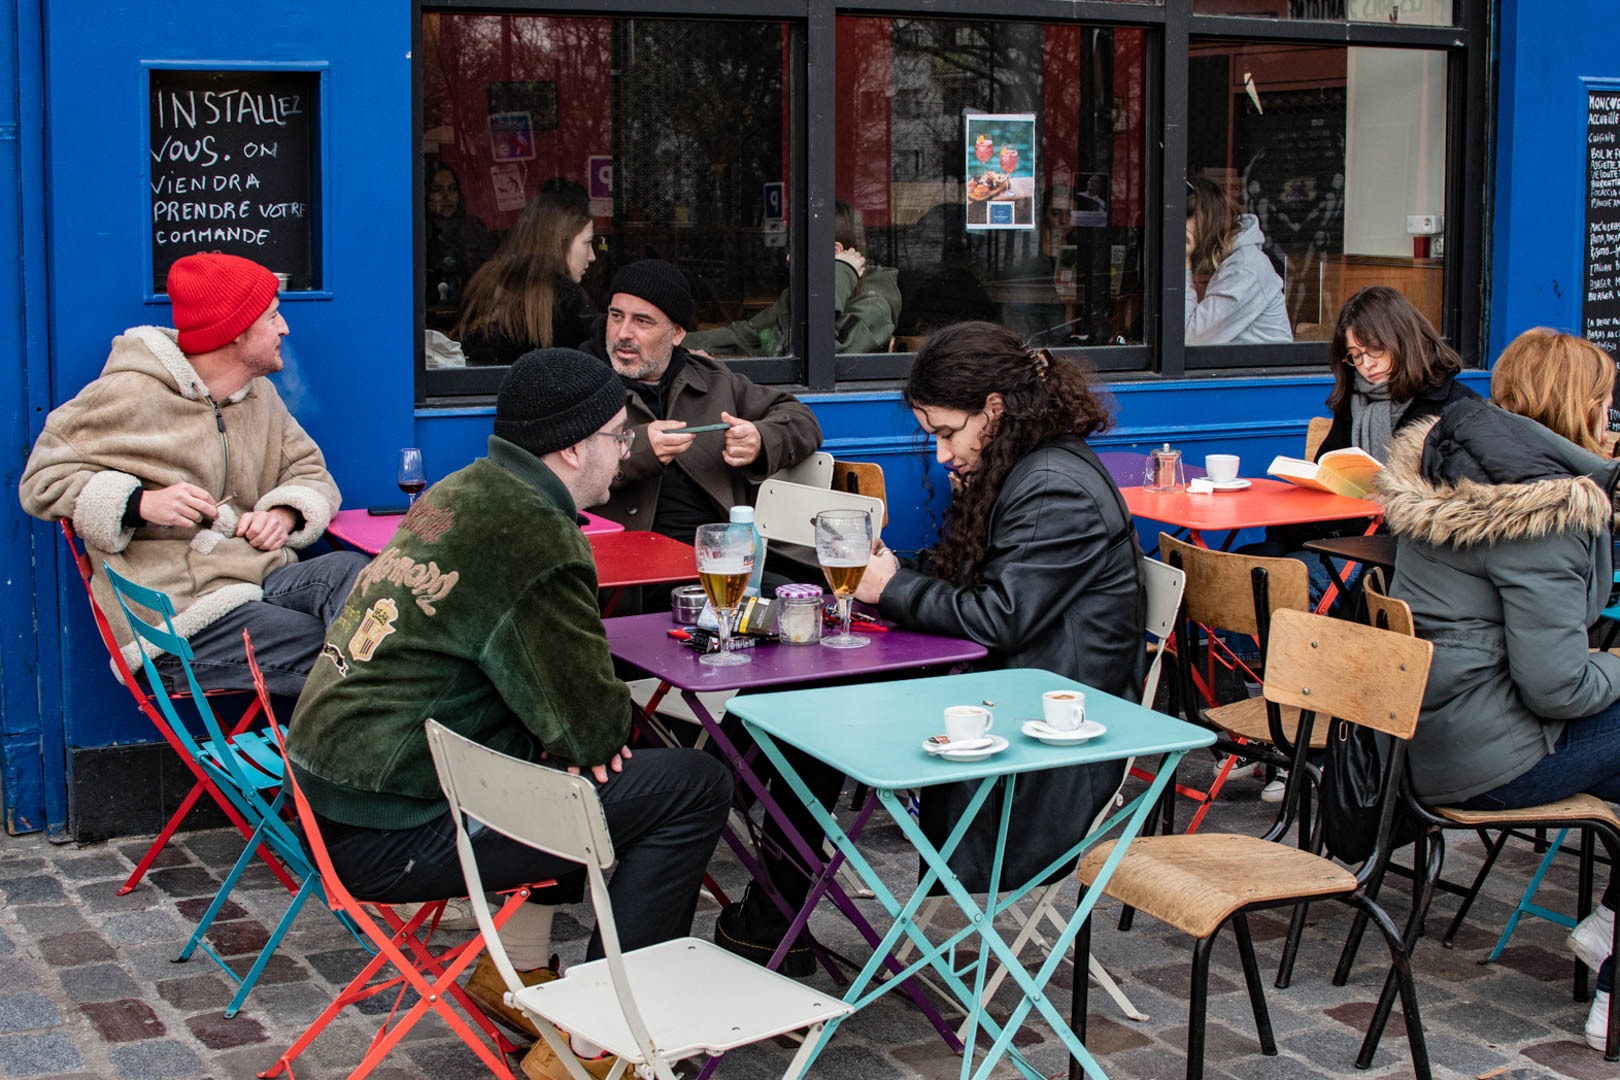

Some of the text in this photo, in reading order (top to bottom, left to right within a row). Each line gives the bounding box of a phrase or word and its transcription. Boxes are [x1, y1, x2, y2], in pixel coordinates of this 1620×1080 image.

[158, 89, 303, 129] INSTALLEZ
[150, 135, 278, 167] VOUS. ON
[153, 199, 307, 222] PRENDRE VOTRE
